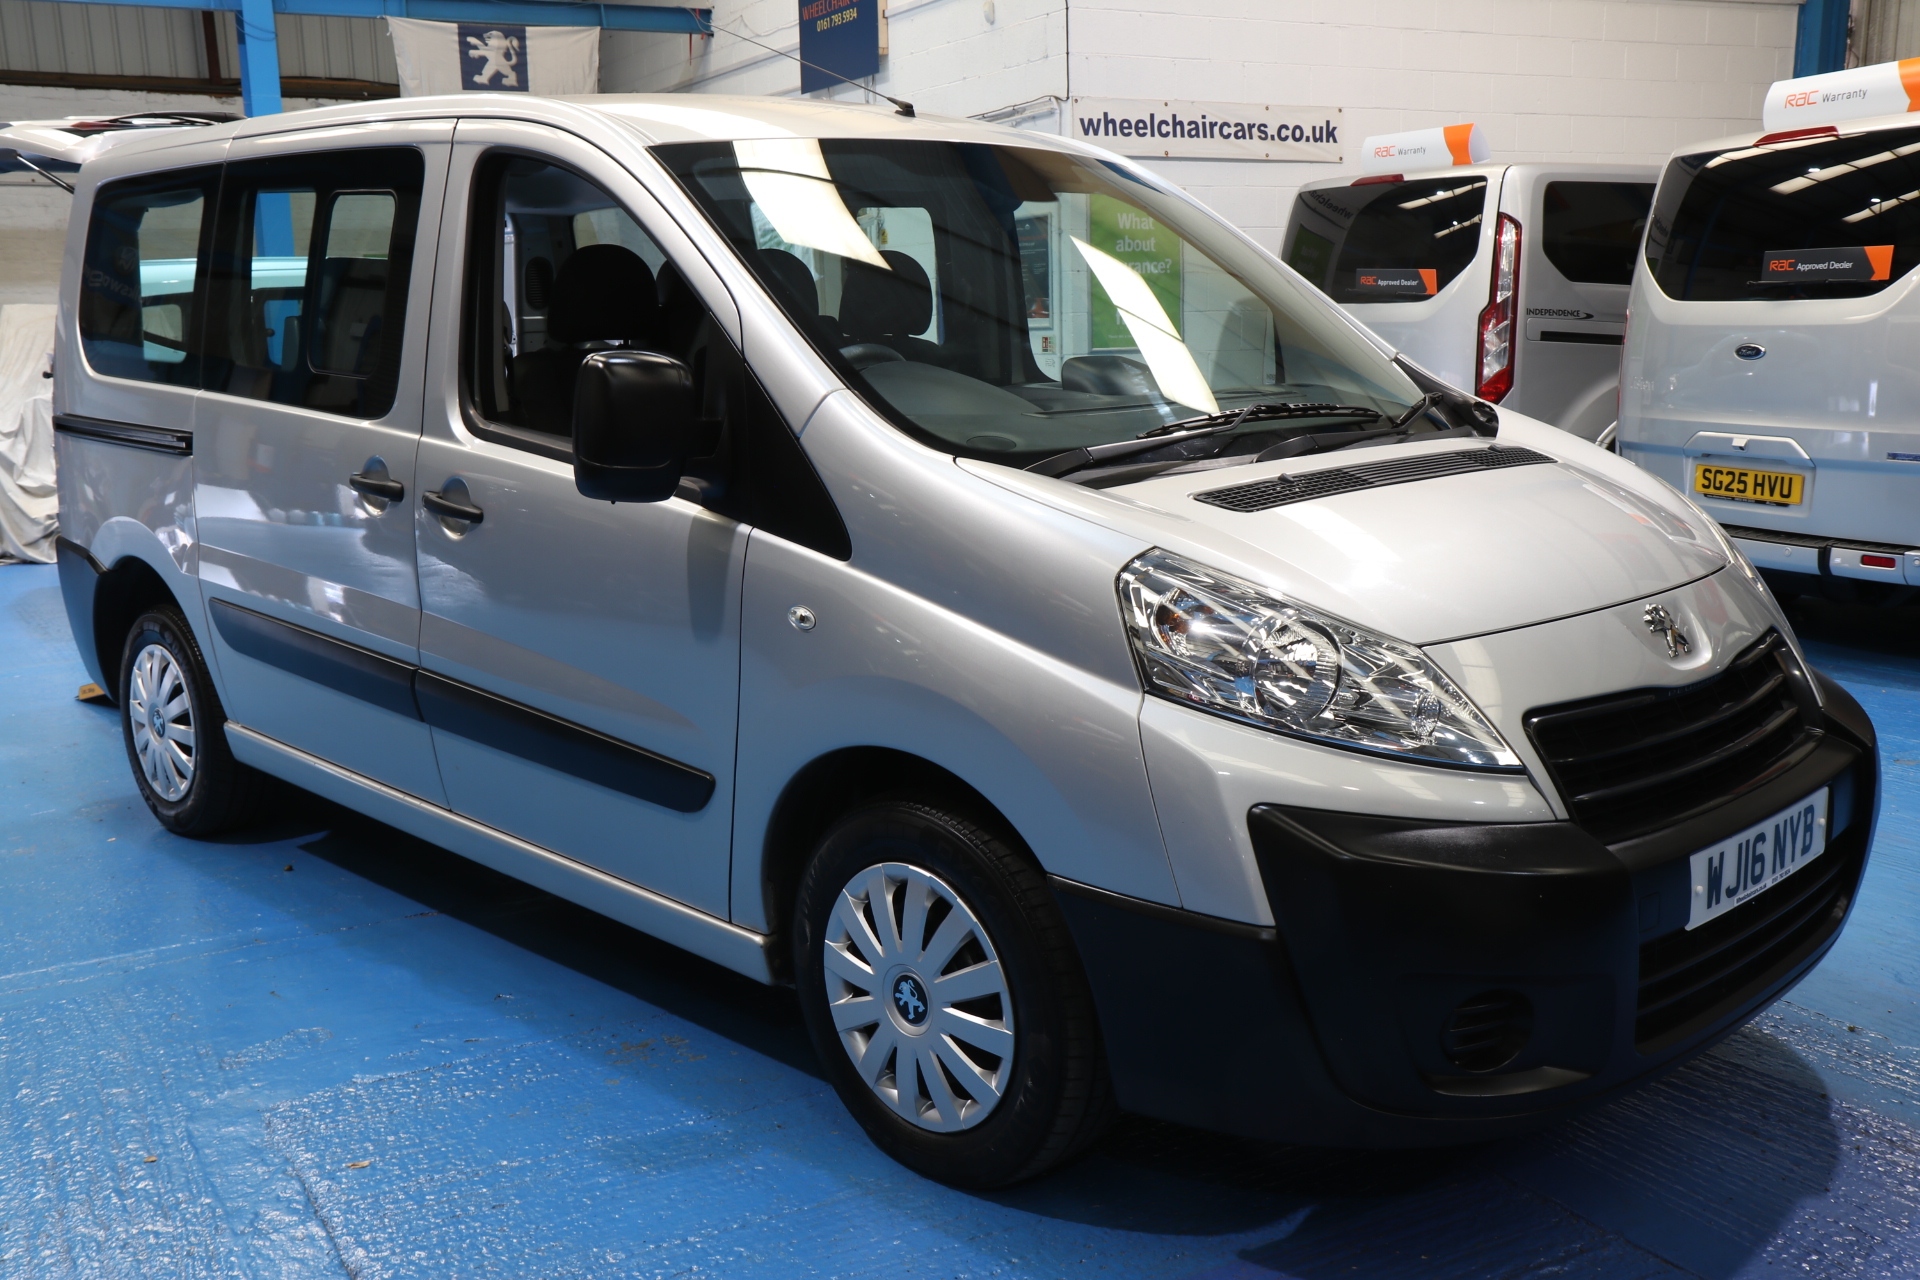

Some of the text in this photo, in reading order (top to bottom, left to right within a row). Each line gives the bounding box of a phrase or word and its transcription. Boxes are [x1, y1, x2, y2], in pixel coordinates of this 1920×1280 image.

[816, 7, 858, 32] 0161 793 5934
[1822, 88, 1868, 103] Warranty
[1079, 111, 1338, 143] wheelchaircars.co.uk
[1397, 146, 1426, 156] Warranty
[1117, 212, 1155, 230] What
[1115, 235, 1156, 252] about
[1127, 258, 1172, 274] rance?
[1796, 262, 1829, 272] Approved
[1829, 260, 1853, 270] Dealer
[1377, 279, 1401, 287] Approved
[1526, 308, 1581, 317] INDEPENDENCE
[1701, 468, 1793, 498] SG25 HVU
[1706, 804, 1815, 910] WJ16 NYB
